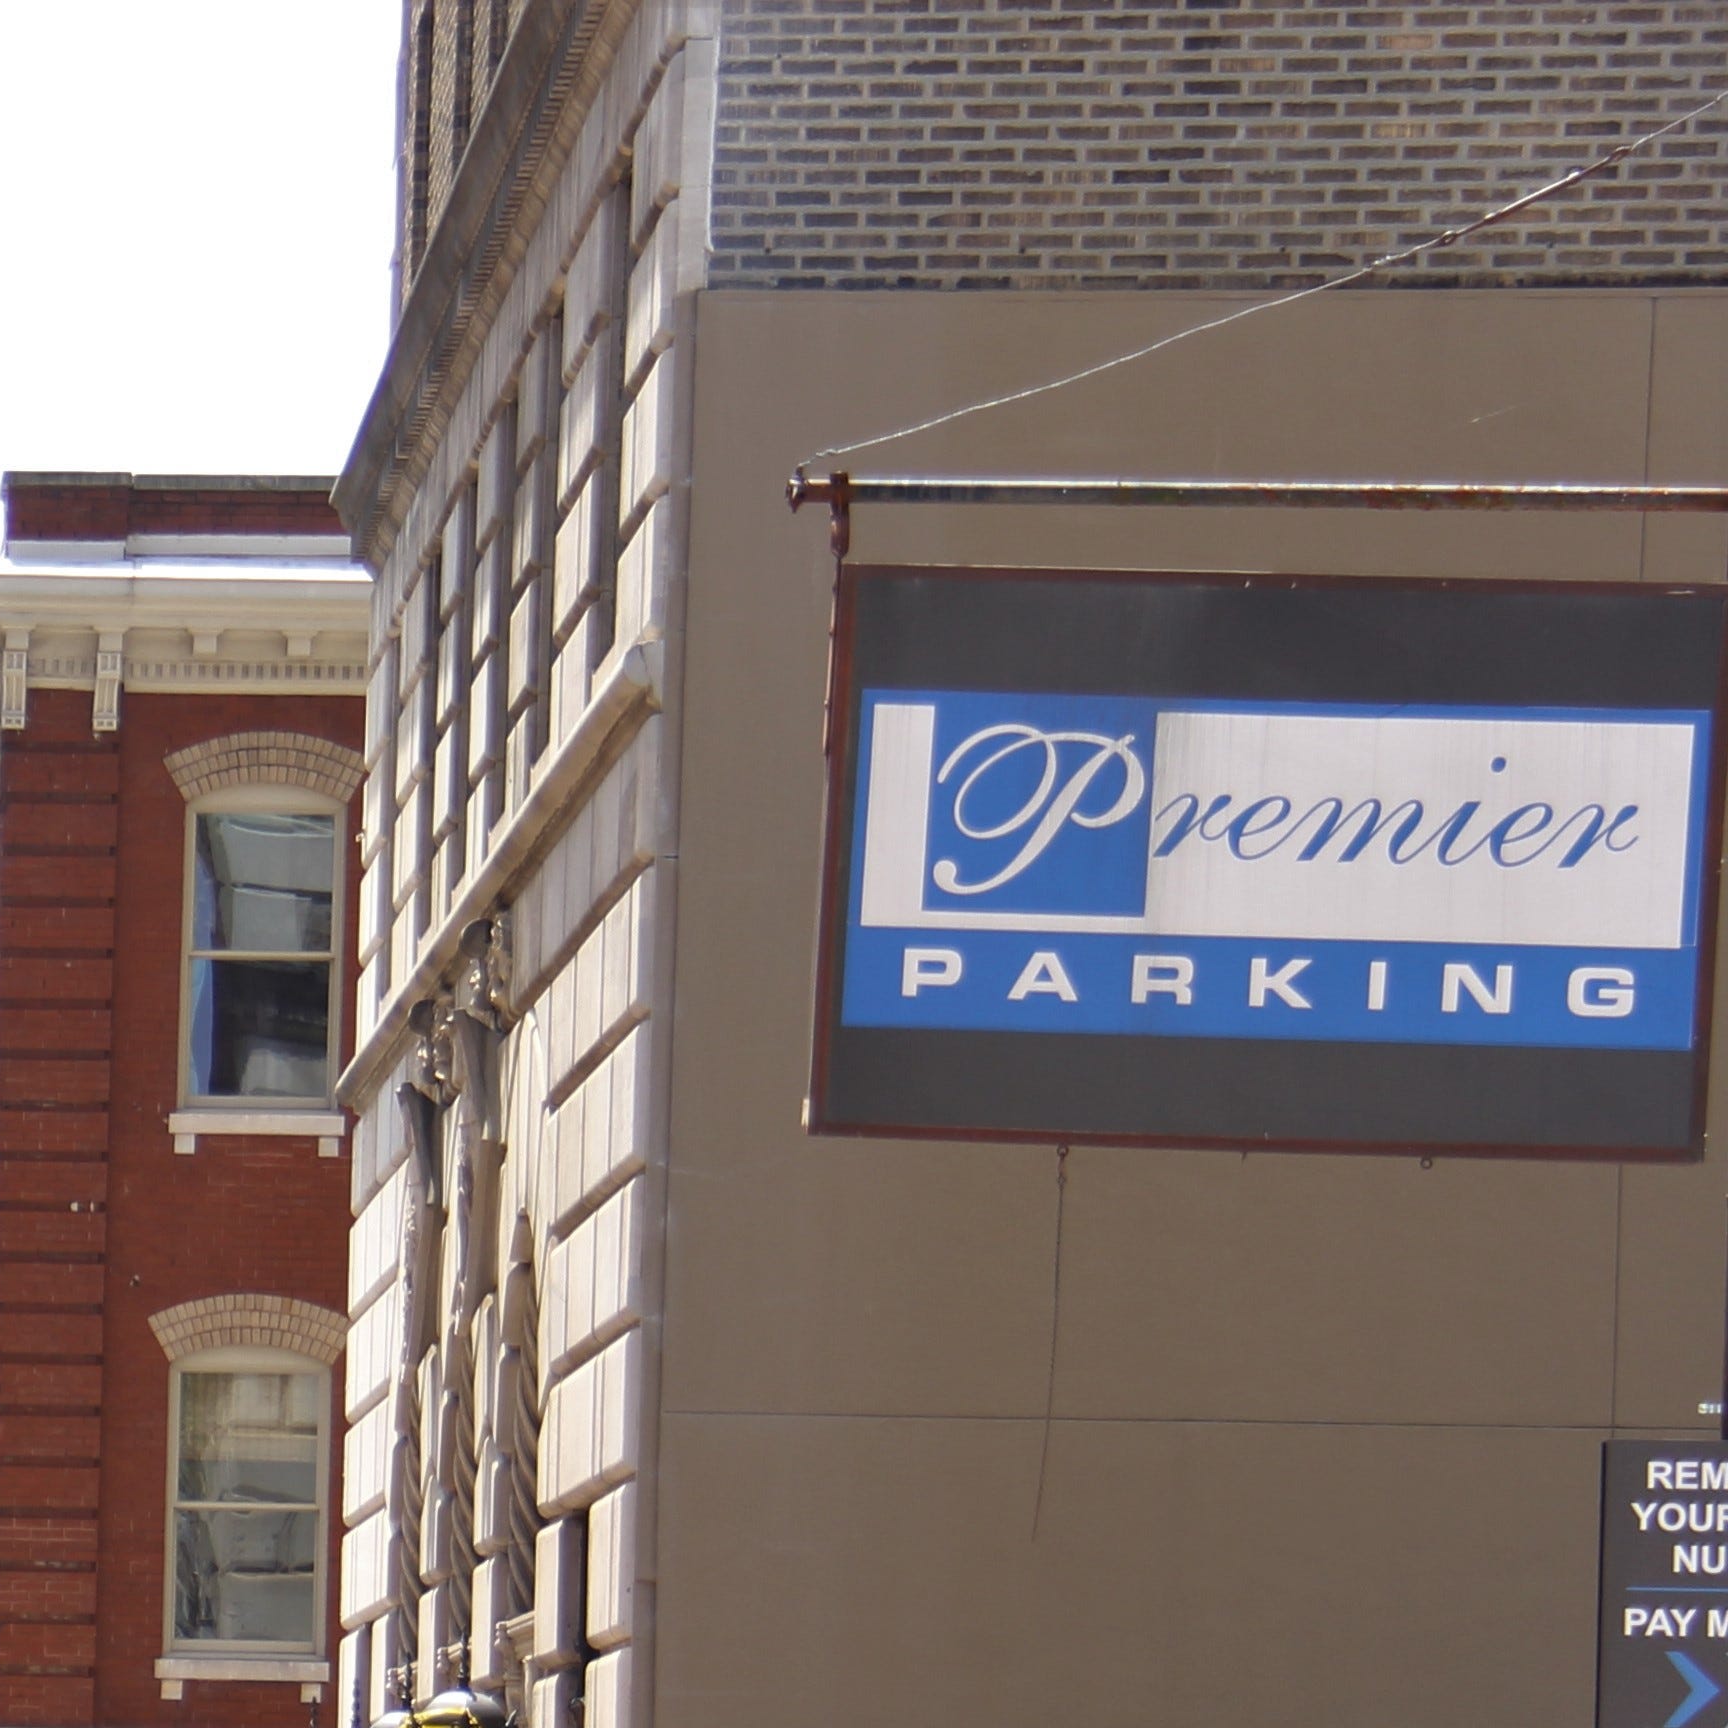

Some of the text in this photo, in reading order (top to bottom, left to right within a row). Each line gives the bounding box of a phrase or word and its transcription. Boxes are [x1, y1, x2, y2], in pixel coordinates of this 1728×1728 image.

[933, 723, 1639, 895] Premier
[901, 948, 1636, 1018] PARKING
[1624, 1608, 1696, 1637] PAY
